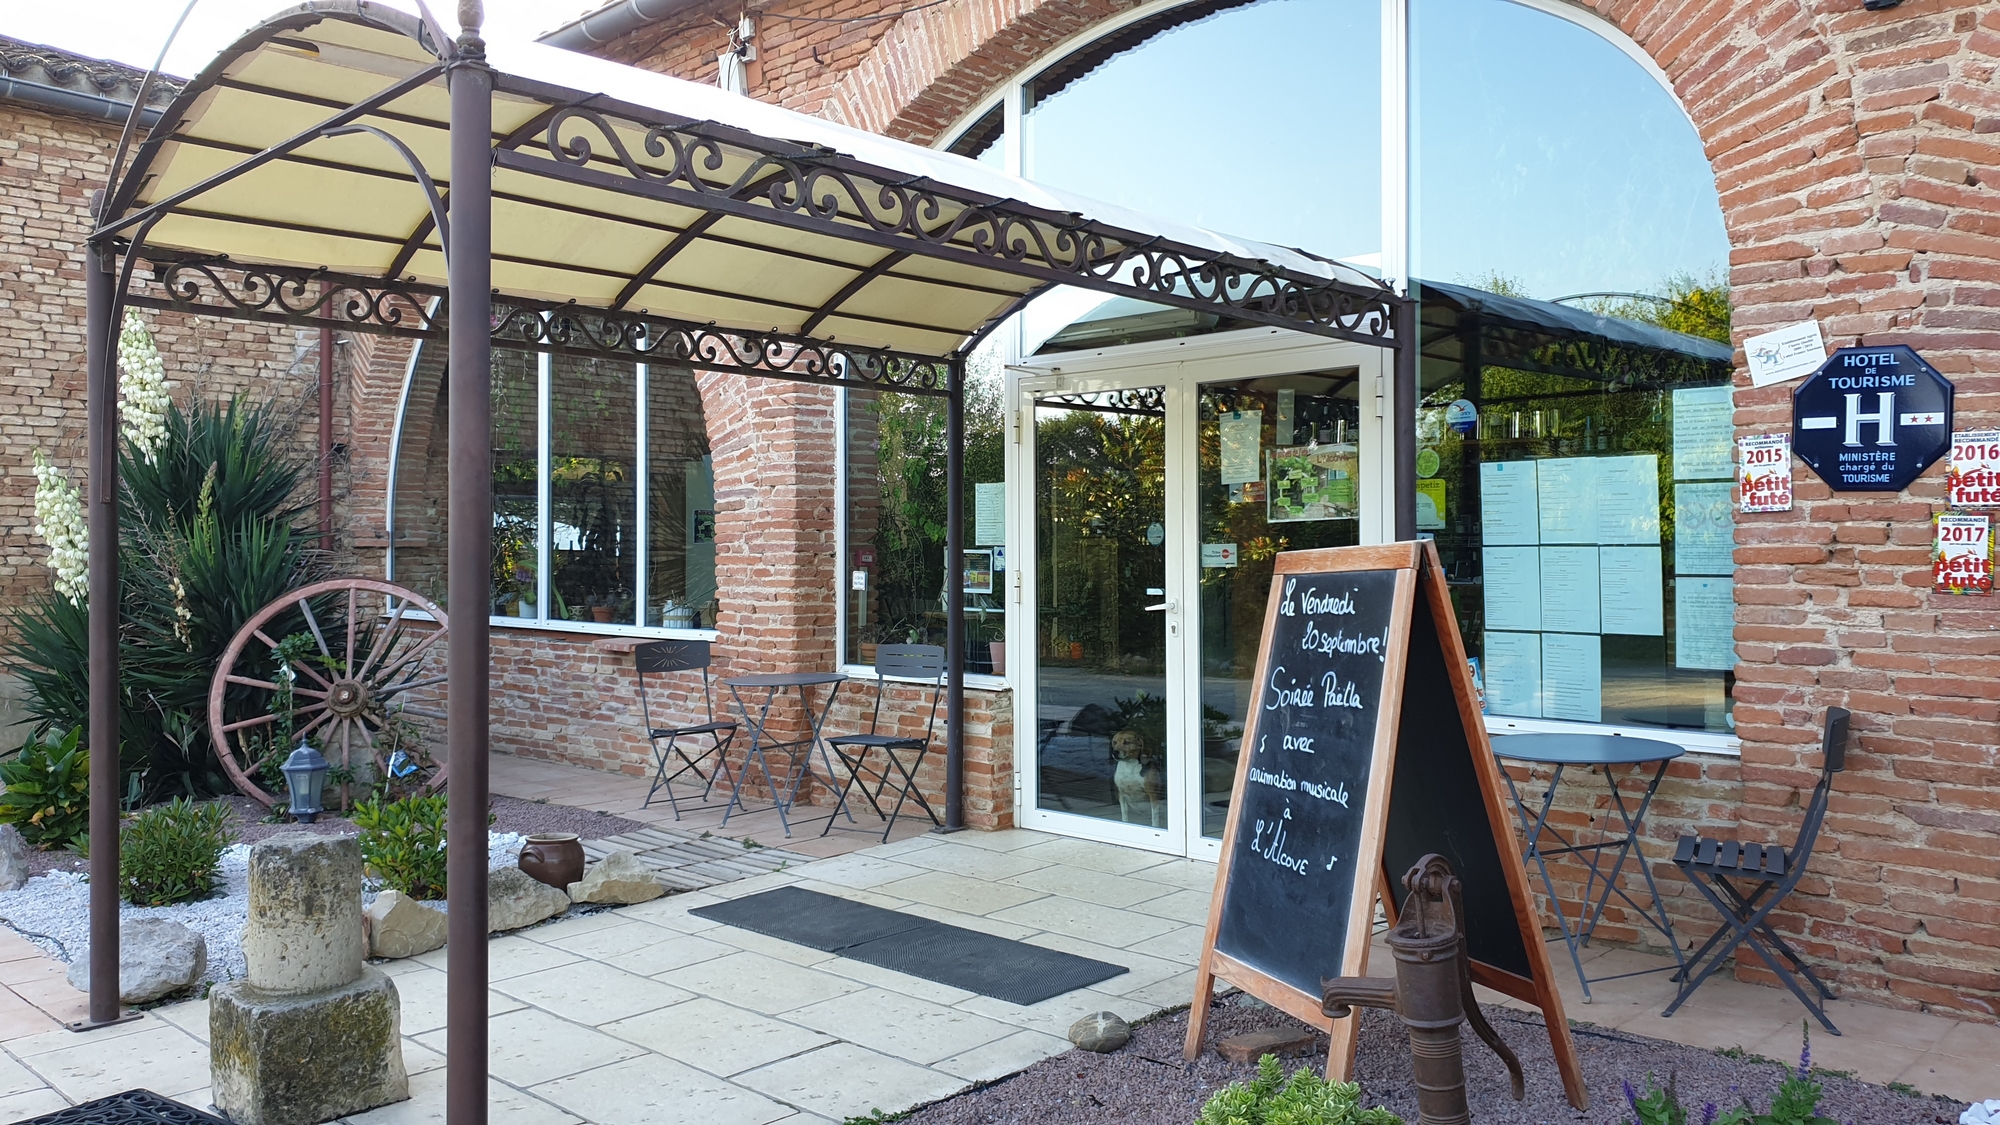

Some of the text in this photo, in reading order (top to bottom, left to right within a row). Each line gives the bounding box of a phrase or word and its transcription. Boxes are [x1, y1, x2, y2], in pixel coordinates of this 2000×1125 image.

[1843, 353, 1900, 367] HOTEL
[1865, 367, 1877, 375] DE
[1828, 374, 1916, 389] TOURISME
[1842, 392, 1898, 447] H
[1745, 439, 1783, 447] RECOMMANDÉ
[1746, 448, 1783, 464] 2015
[1839, 451, 1896, 461] MINISTÈRE
[1953, 444, 2000, 461] 2016
[1839, 462, 1895, 473] chargé du
[1741, 476, 1790, 496] petit
[1842, 474, 1890, 483] TOURISME
[1947, 471, 2000, 492] petit
[1749, 491, 1790, 506] futé
[1956, 487, 2000, 503] futé
[1941, 527, 1985, 542] 2017
[1933, 557, 1992, 576] petit
[1943, 572, 1992, 589] futé
[1280, 578, 1359, 616] Le Vendredi
[1302, 620, 1319, 650] 20
[1266, 666, 1314, 710] Soirée
[1283, 734, 1315, 754] avec
[1250, 767, 1349, 809] animation musicale
[1283, 798, 1292, 820] à
